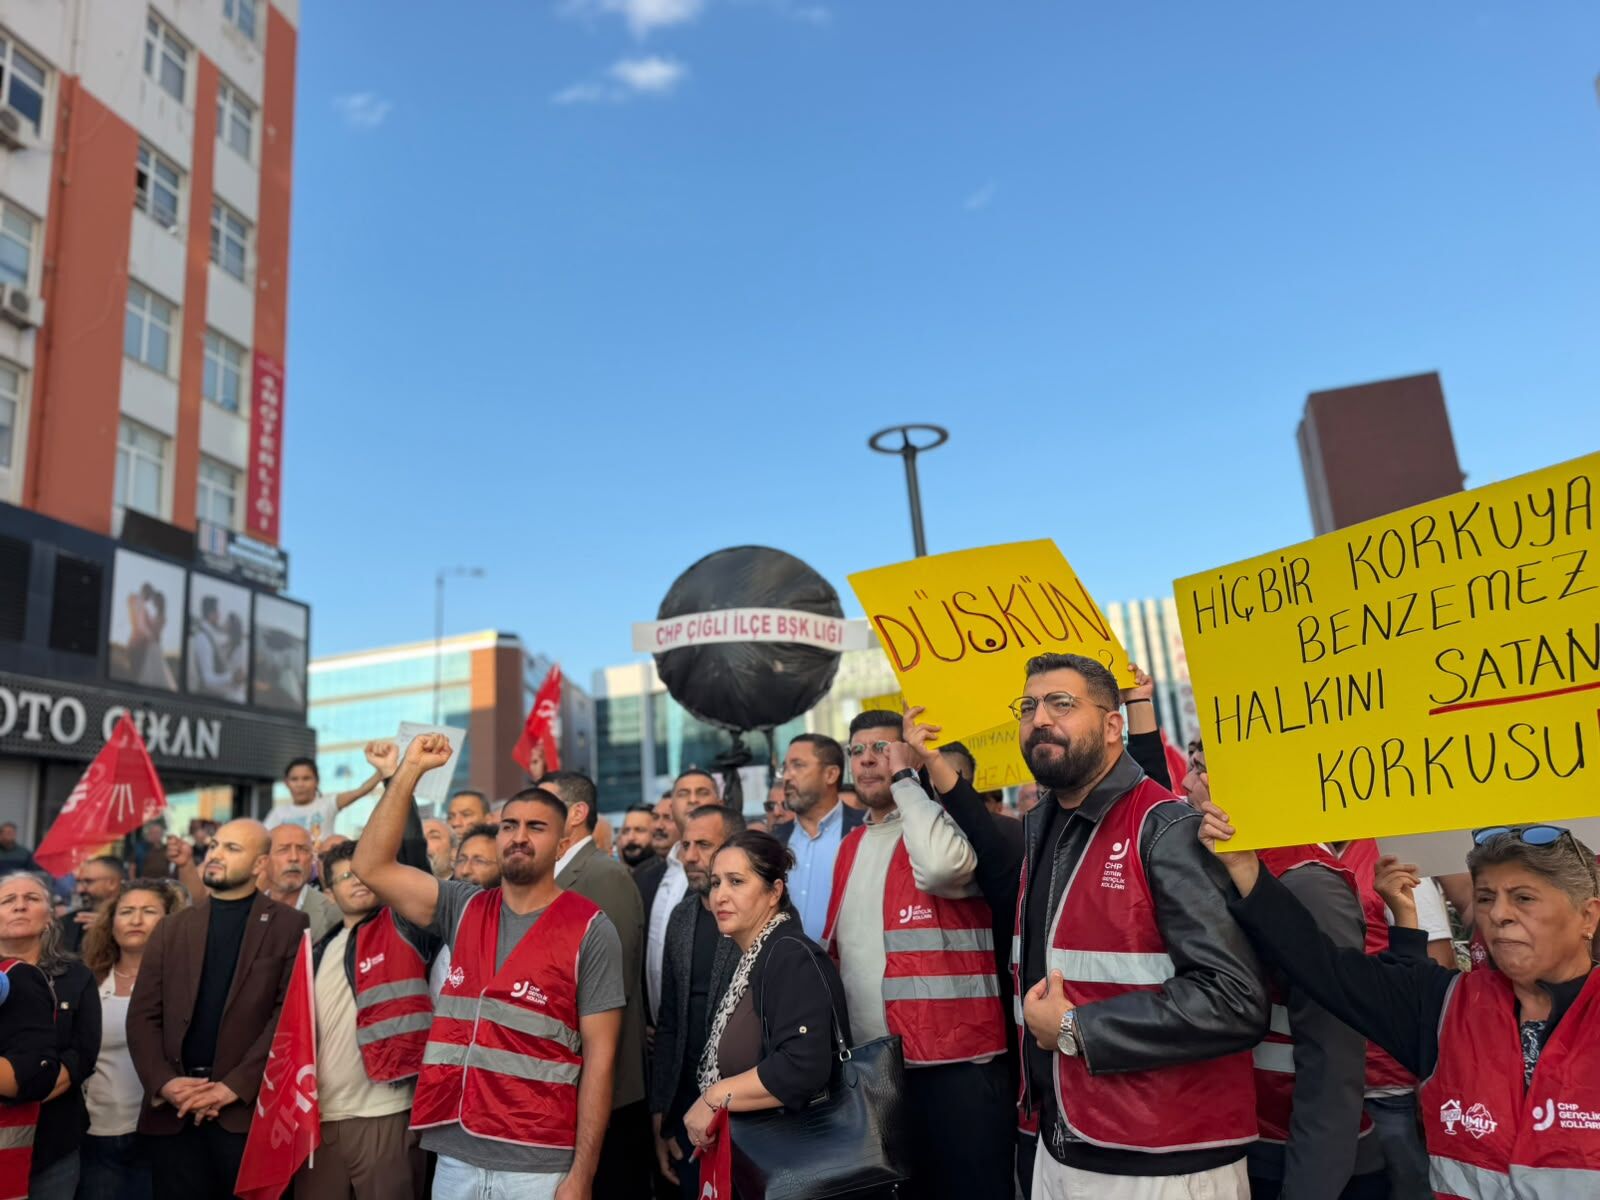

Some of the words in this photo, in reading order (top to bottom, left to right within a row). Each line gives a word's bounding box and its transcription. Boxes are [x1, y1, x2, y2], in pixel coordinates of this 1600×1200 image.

[1192, 556, 1313, 634] HİÇBİR
[1347, 475, 1592, 590] KORKUYA
[656, 623, 682, 645] CHP
[687, 612, 728, 643] ÇİĞLİ
[733, 611, 771, 638] İLÇE
[777, 616, 809, 639] BŞK
[1297, 549, 1599, 664] BENZEMEZ
[1213, 668, 1384, 744] HALKINI
[1429, 622, 1600, 705] SATAN
[1317, 721, 1584, 812] KORKUSU
[1461, 1114, 1498, 1132] UMUT
[1557, 1102, 1579, 1110] CHP
